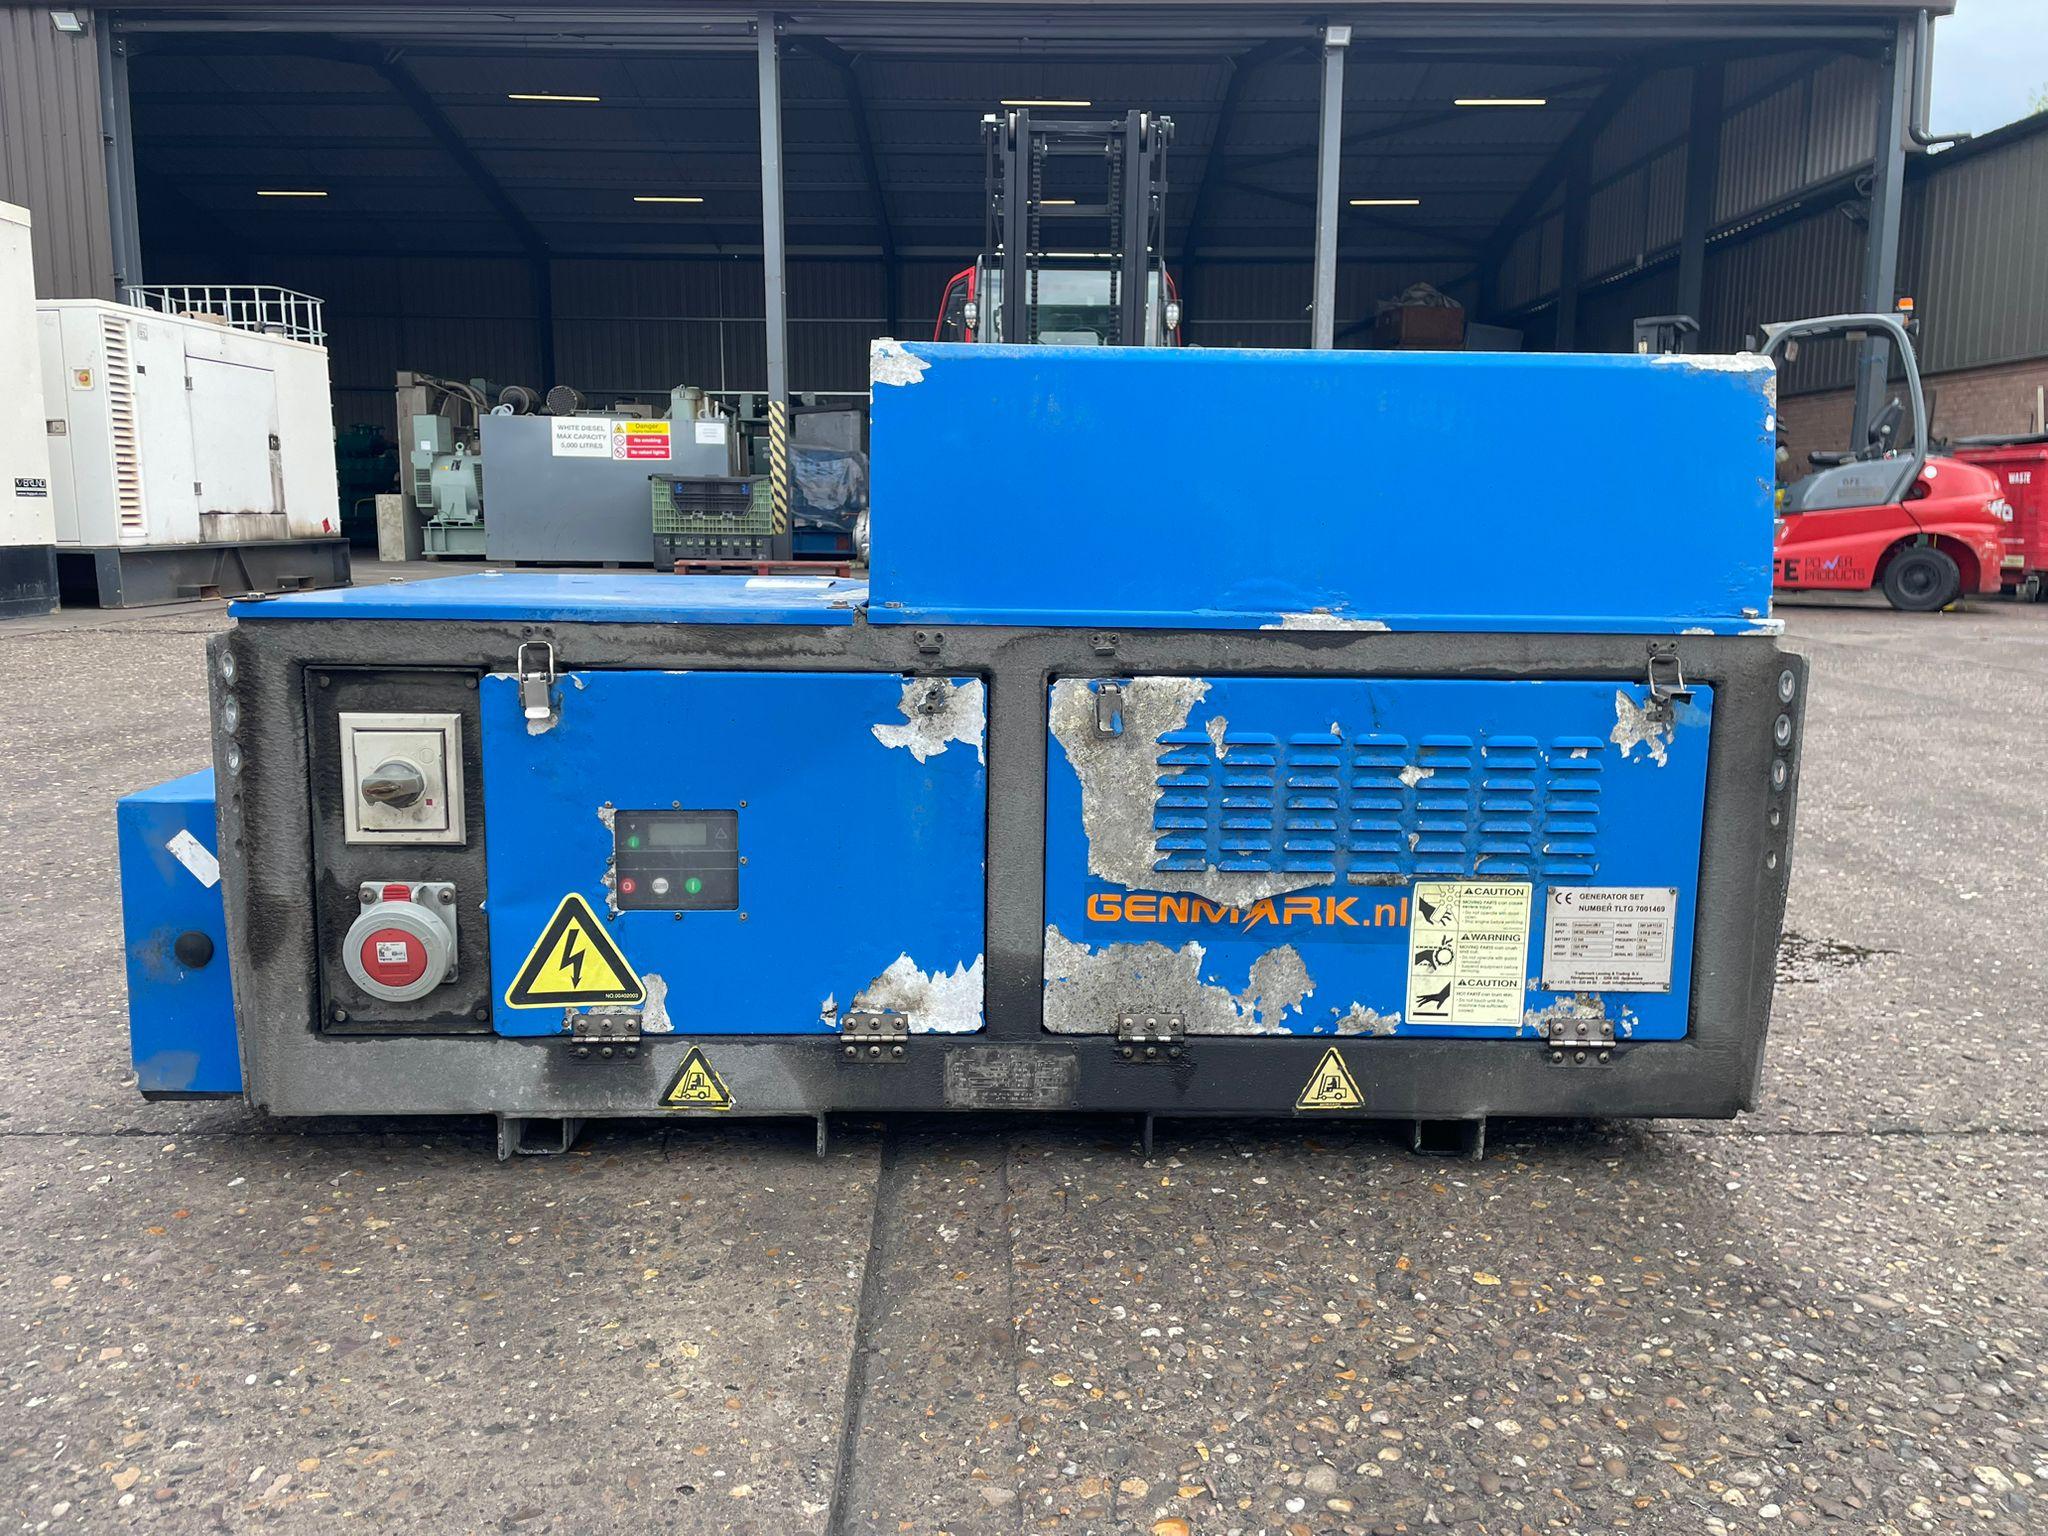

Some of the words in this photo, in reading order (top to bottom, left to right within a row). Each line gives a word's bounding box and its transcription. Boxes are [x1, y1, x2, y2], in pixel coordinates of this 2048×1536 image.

[2008, 471, 2031, 484] WASTE
[1474, 888, 1524, 896] CAUTION
[1087, 894, 1408, 934] GENMARK.nl
[1468, 979, 1517, 987] CAUTION
